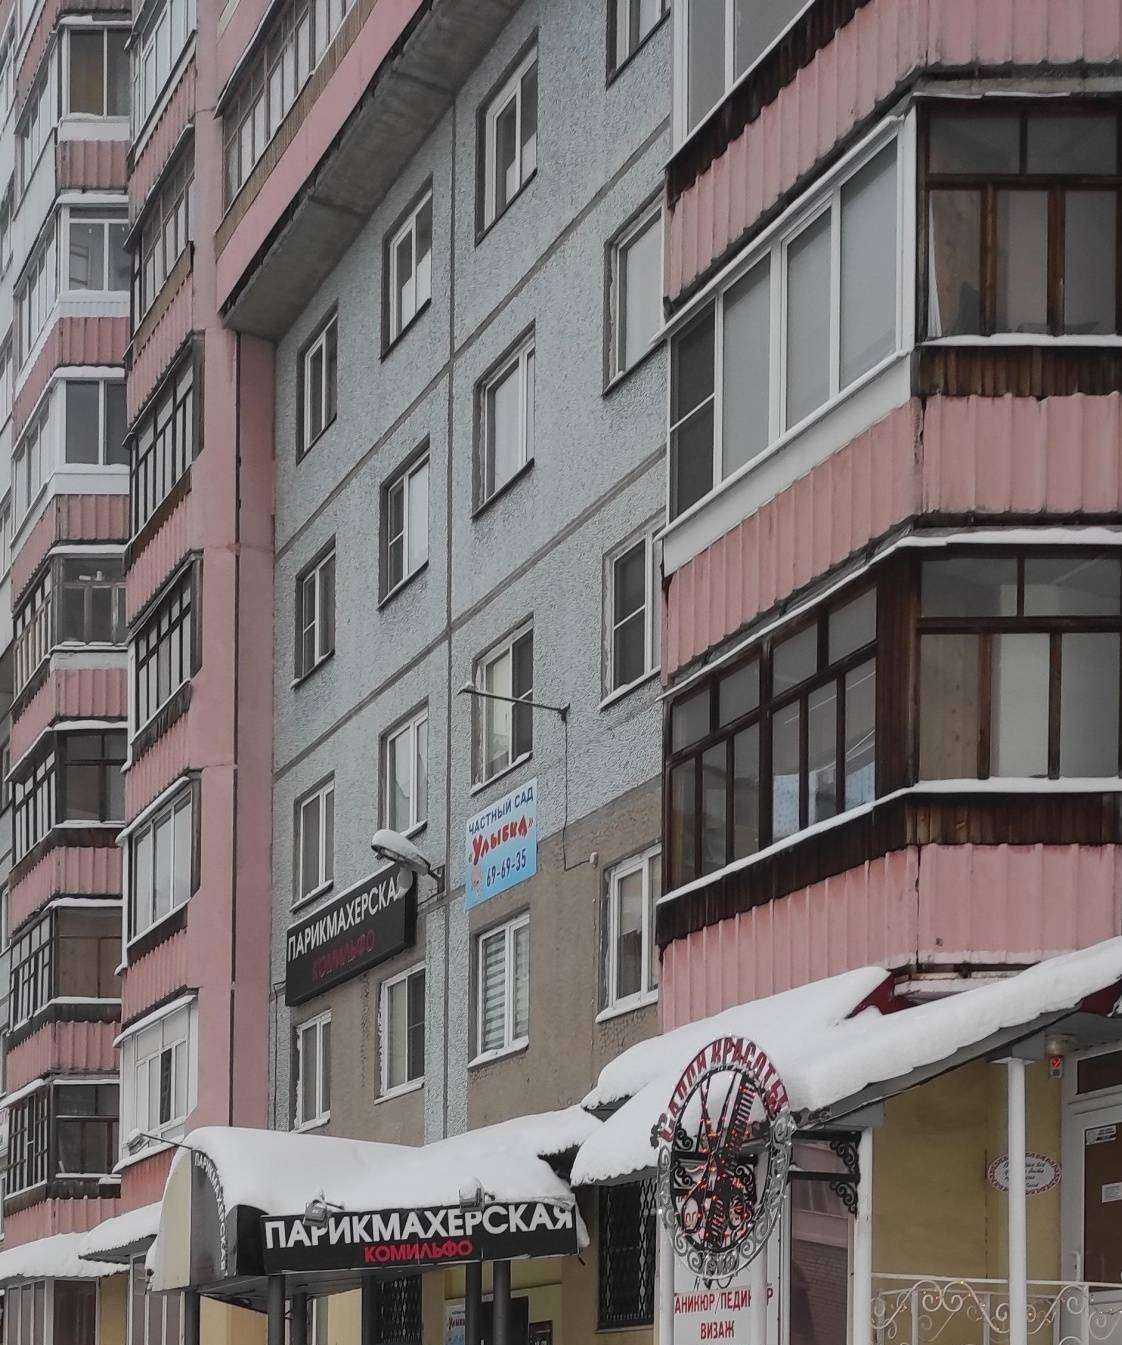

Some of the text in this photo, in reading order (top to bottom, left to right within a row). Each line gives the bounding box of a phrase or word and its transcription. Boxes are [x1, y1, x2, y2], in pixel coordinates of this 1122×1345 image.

[515, 786, 534, 808] САД
[487, 848, 527, 887] 69-69-35
[265, 1202, 573, 1249] ПАРИКМАХЕРСКАЯ
[364, 1239, 474, 1264] КОМИЛЬФО
[700, 1320, 735, 1339] ВИЗАЖ
